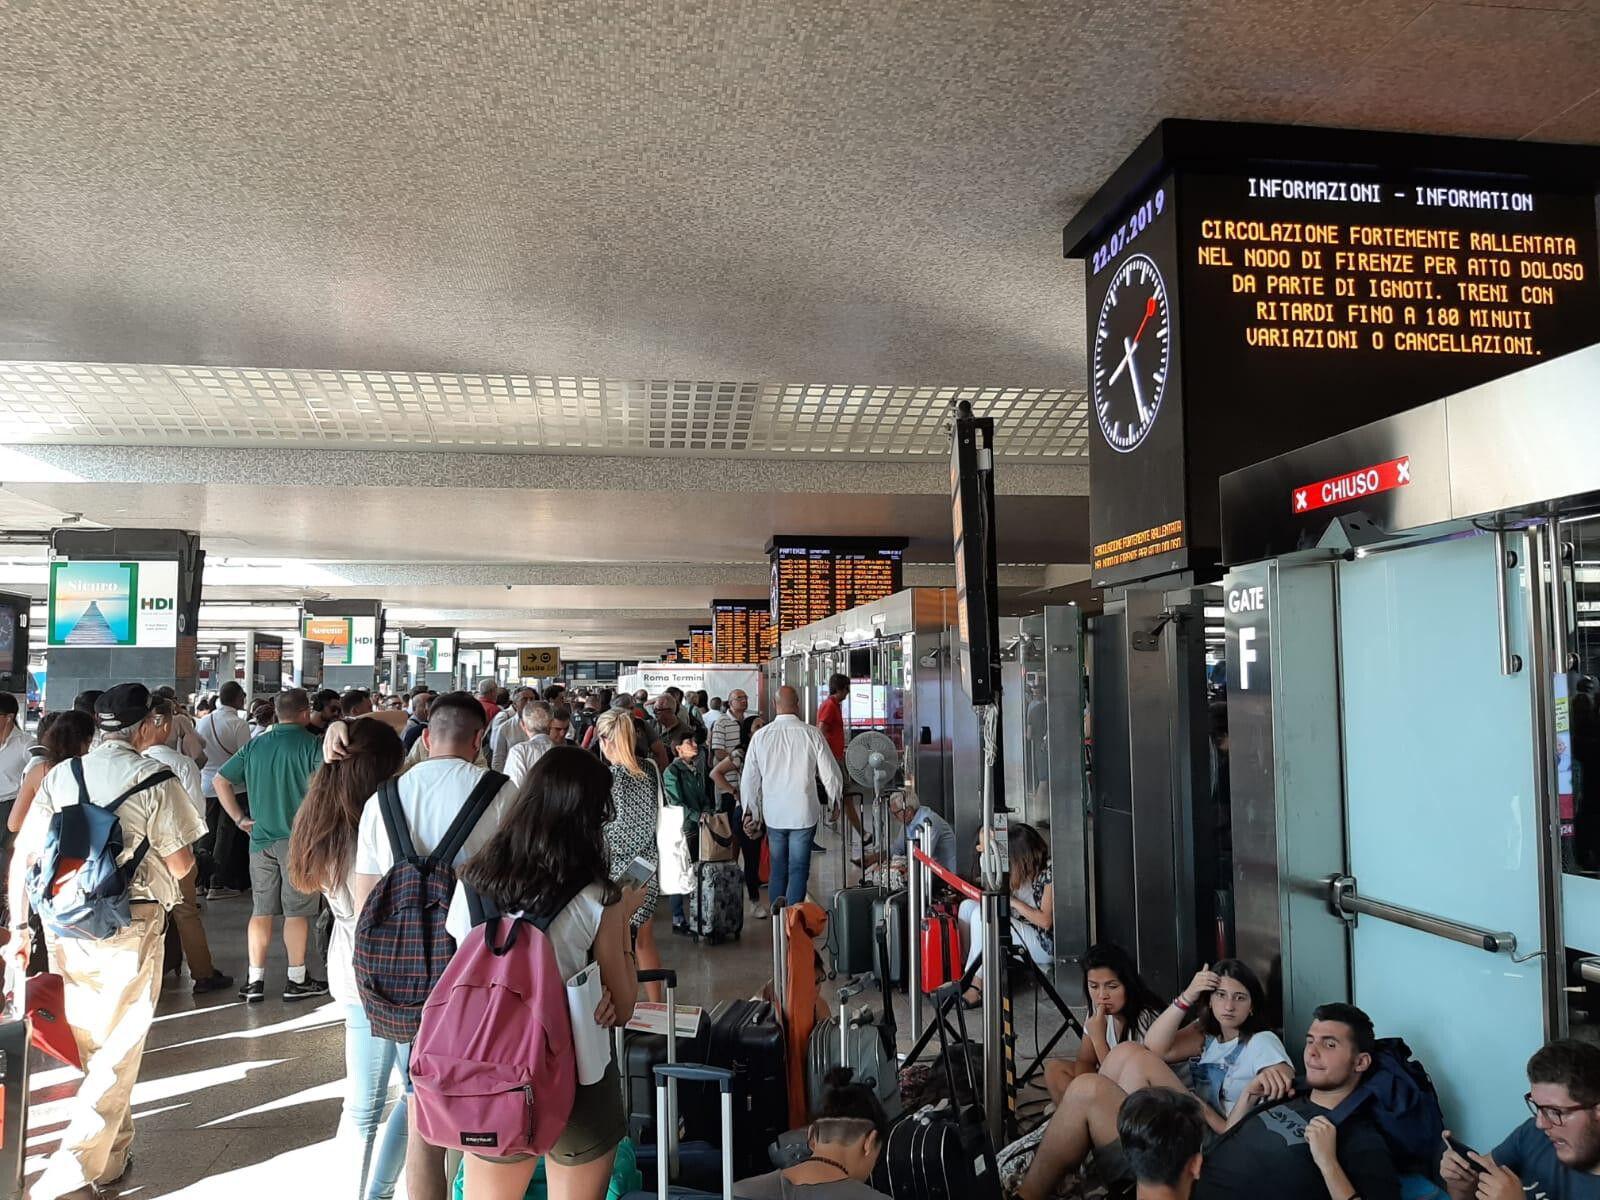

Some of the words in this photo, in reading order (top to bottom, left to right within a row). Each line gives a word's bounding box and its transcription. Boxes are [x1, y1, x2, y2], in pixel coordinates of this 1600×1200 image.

[1249, 178, 1381, 202] INFORMAZIONI
[1416, 186, 1533, 212] INFORMATION
[1093, 188, 1164, 275] 22.07.2019
[1202, 220, 1339, 244] CIRCOLAZIONE
[1350, 227, 1460, 250] FORTEMENTE
[1470, 233, 1576, 256] RALLENTATA
[1198, 246, 1233, 266] NEL
[1245, 248, 1291, 268] NODO
[1302, 250, 1322, 270] DI
[1336, 252, 1414, 273] FIRENZE
[1425, 256, 1457, 276] PER
[1468, 258, 1511, 278] ATTO
[1521, 260, 1584, 281] DOLOSO
[1233, 274, 1257, 293] DA
[1267, 275, 1325, 295] PARTE
[1336, 278, 1356, 297] DI
[1369, 279, 1442, 300] IGNOTI.
[1457, 283, 1508, 302] TRENI
[1521, 286, 1554, 305] CON
[1256, 301, 1335, 322] RITARDI
[1348, 305, 1393, 324] FINO
[1404, 306, 1415, 325] A
[1426, 308, 1460, 327] 180
[1470, 309, 1532, 330] MINUTI
[1246, 327, 1358, 350] VARIAZIONI
[1372, 330, 1384, 350] O
[1395, 331, 1542, 355] CANCELLAZIONI.
[1321, 470, 1379, 503] CHIUSO
[141, 598, 173, 610] HDI
[1228, 586, 1264, 613] GATE
[354, 637, 373, 645] HDI
[1239, 627, 1256, 689] F
[643, 673, 669, 682] Roma
[671, 673, 705, 682] Termini
